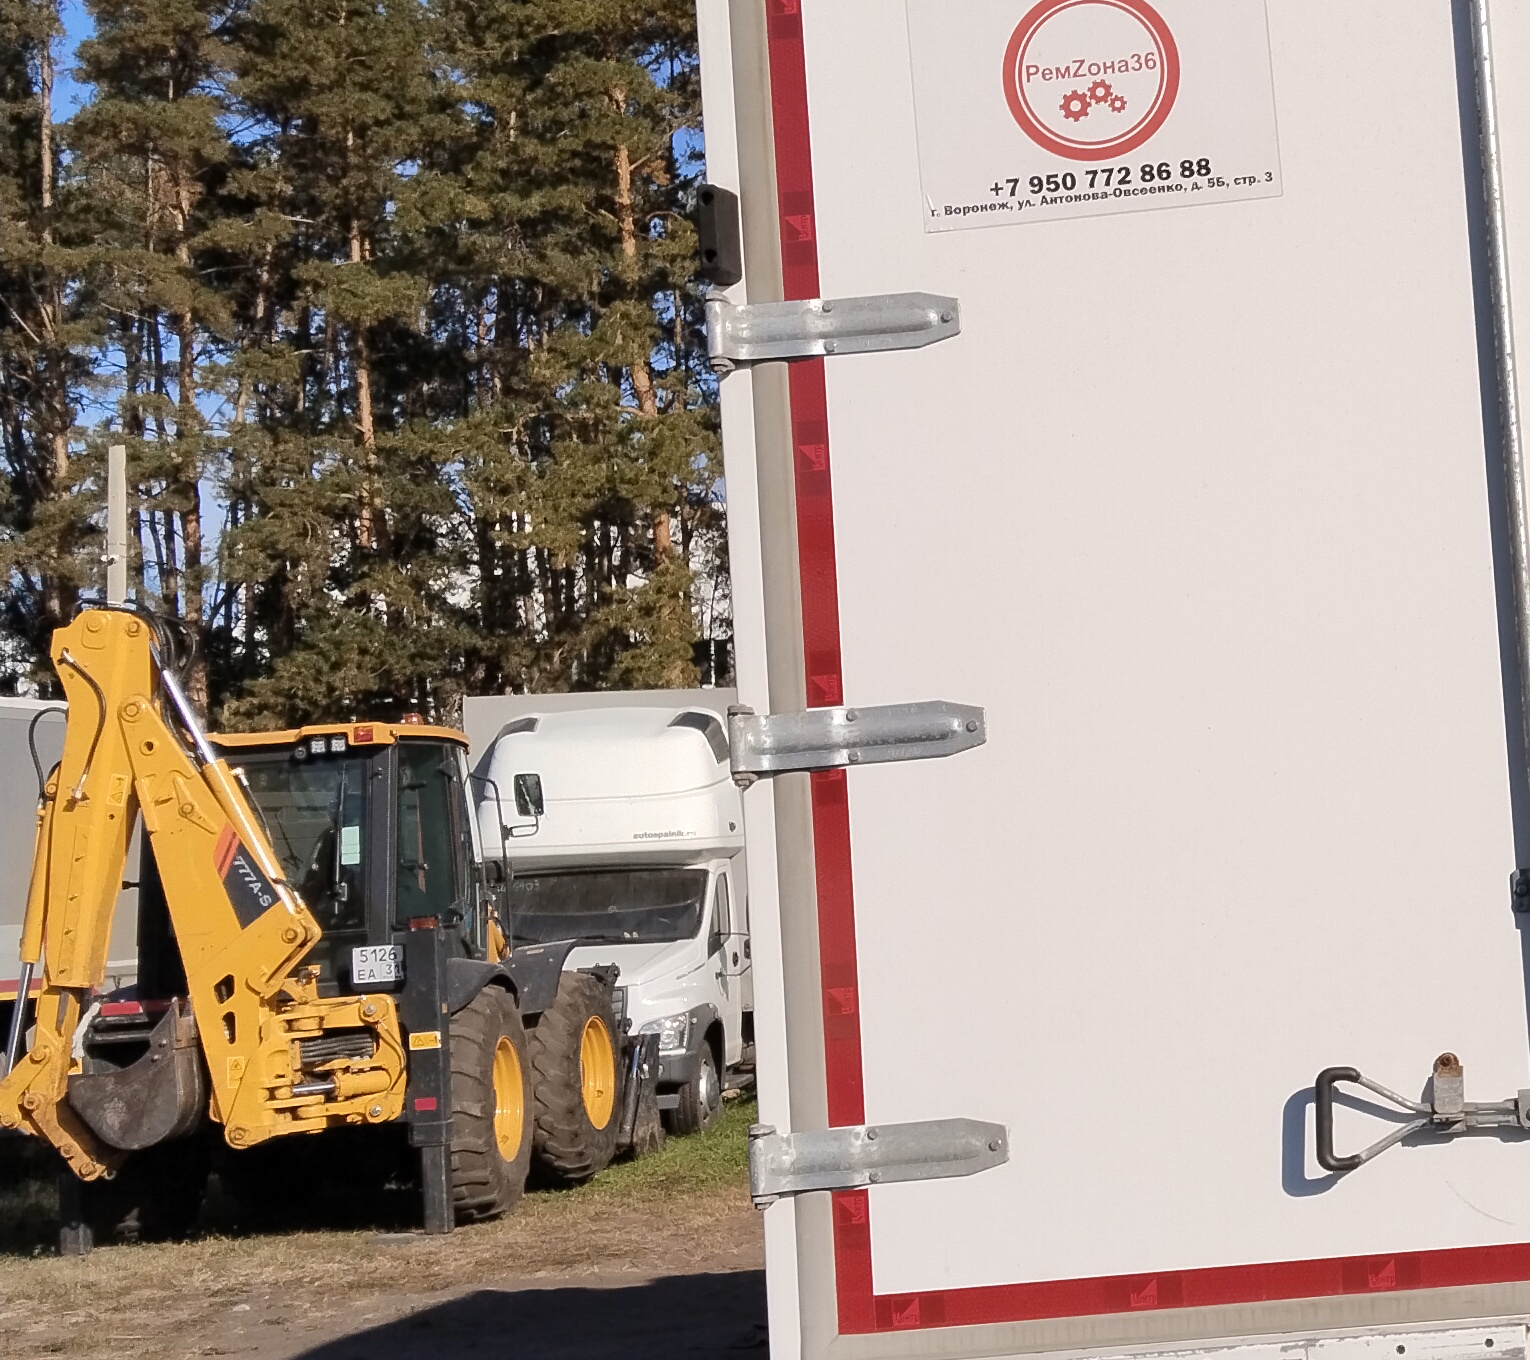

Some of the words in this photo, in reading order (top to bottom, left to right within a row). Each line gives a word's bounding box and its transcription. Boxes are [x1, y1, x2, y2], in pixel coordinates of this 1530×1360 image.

[1025, 51, 1157, 83] РемZона36
[989, 177, 1020, 197] +7
[1028, 172, 1077, 195] 950
[1085, 166, 1132, 189] 772
[1139, 162, 1172, 183] 86
[1179, 157, 1212, 179] 88
[944, 201, 1014, 217] Воронеж,
[1017, 199, 1036, 211] ул.
[1040, 183, 1188, 206] Антонова-Овсеенко,
[1190, 181, 1204, 192] д.
[1233, 175, 1261, 187] стр.
[1264, 171, 1273, 182] 3
[360, 946, 398, 964] 5126
[357, 968, 377, 981] ЕА
